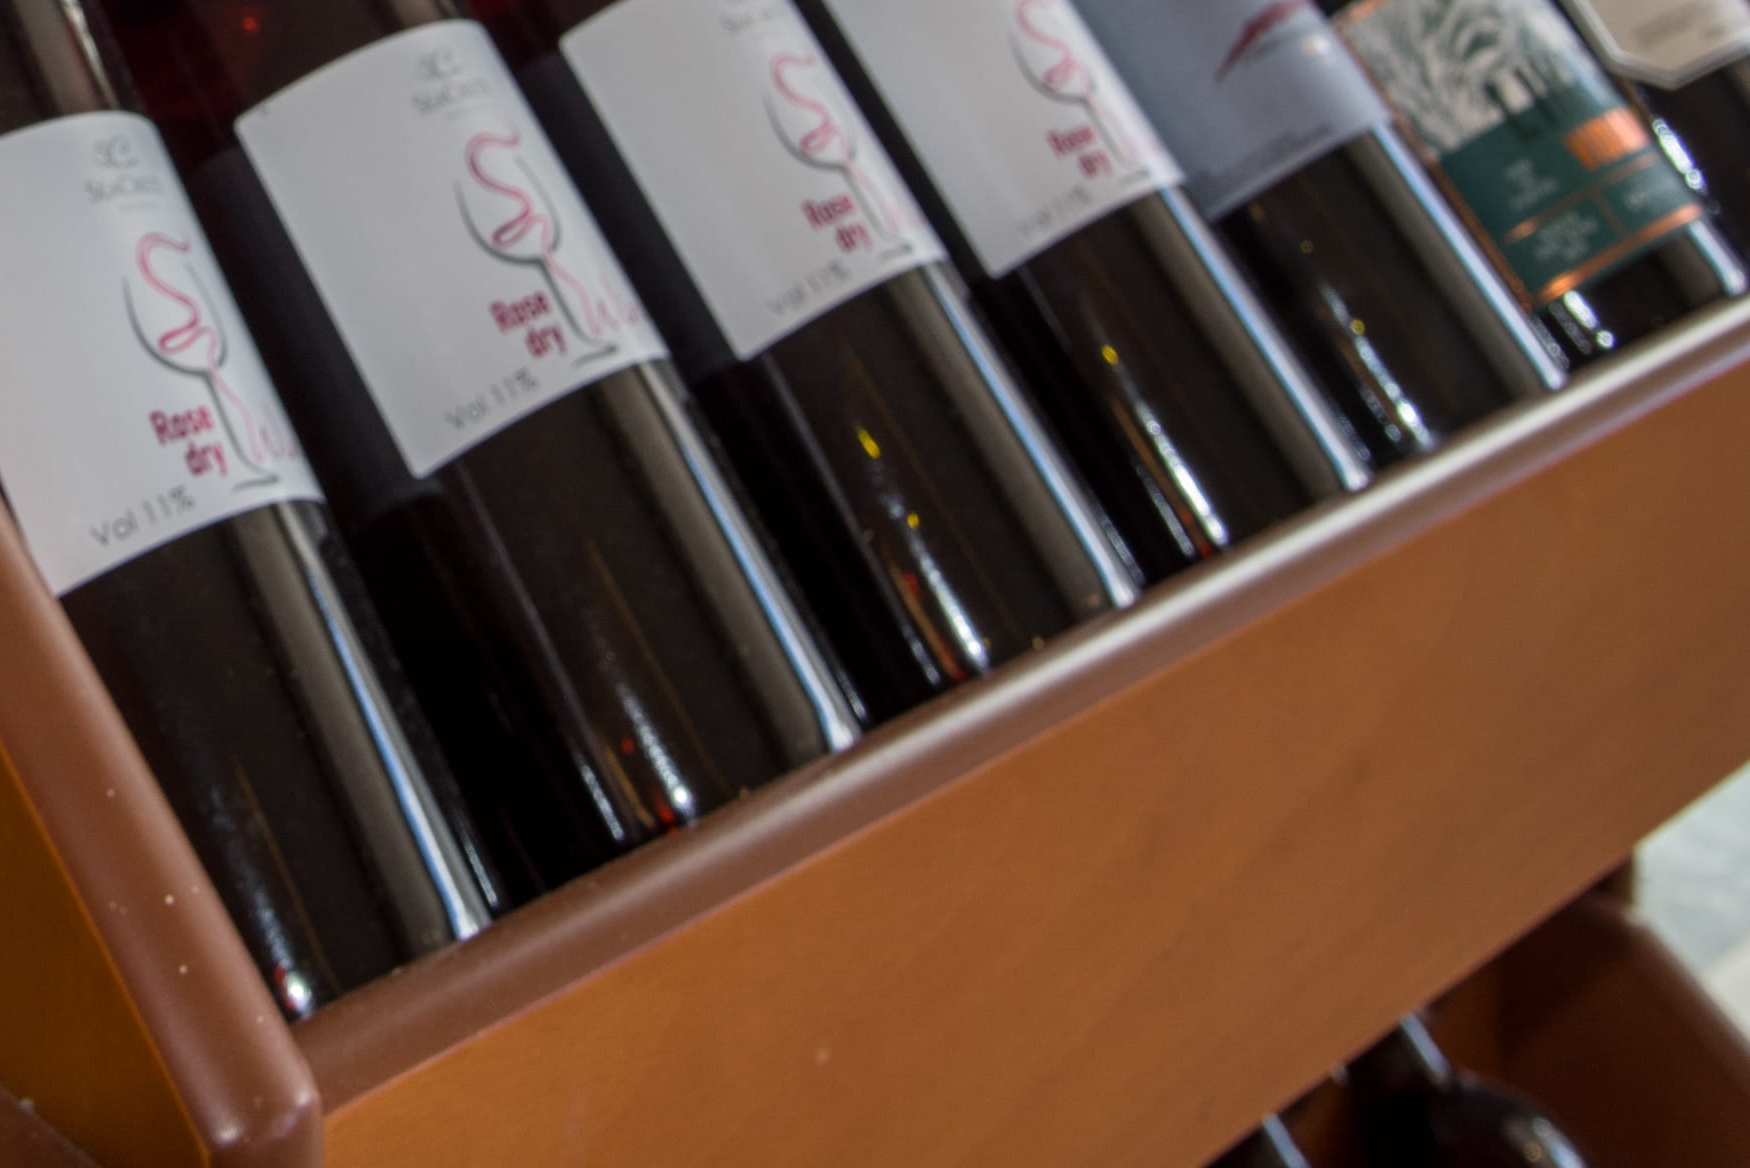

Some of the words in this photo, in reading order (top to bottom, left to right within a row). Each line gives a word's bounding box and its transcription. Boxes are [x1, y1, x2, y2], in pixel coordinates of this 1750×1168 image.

[184, 441, 228, 478] dry
[89, 507, 139, 547] Vol
[141, 484, 197, 525] 11%
